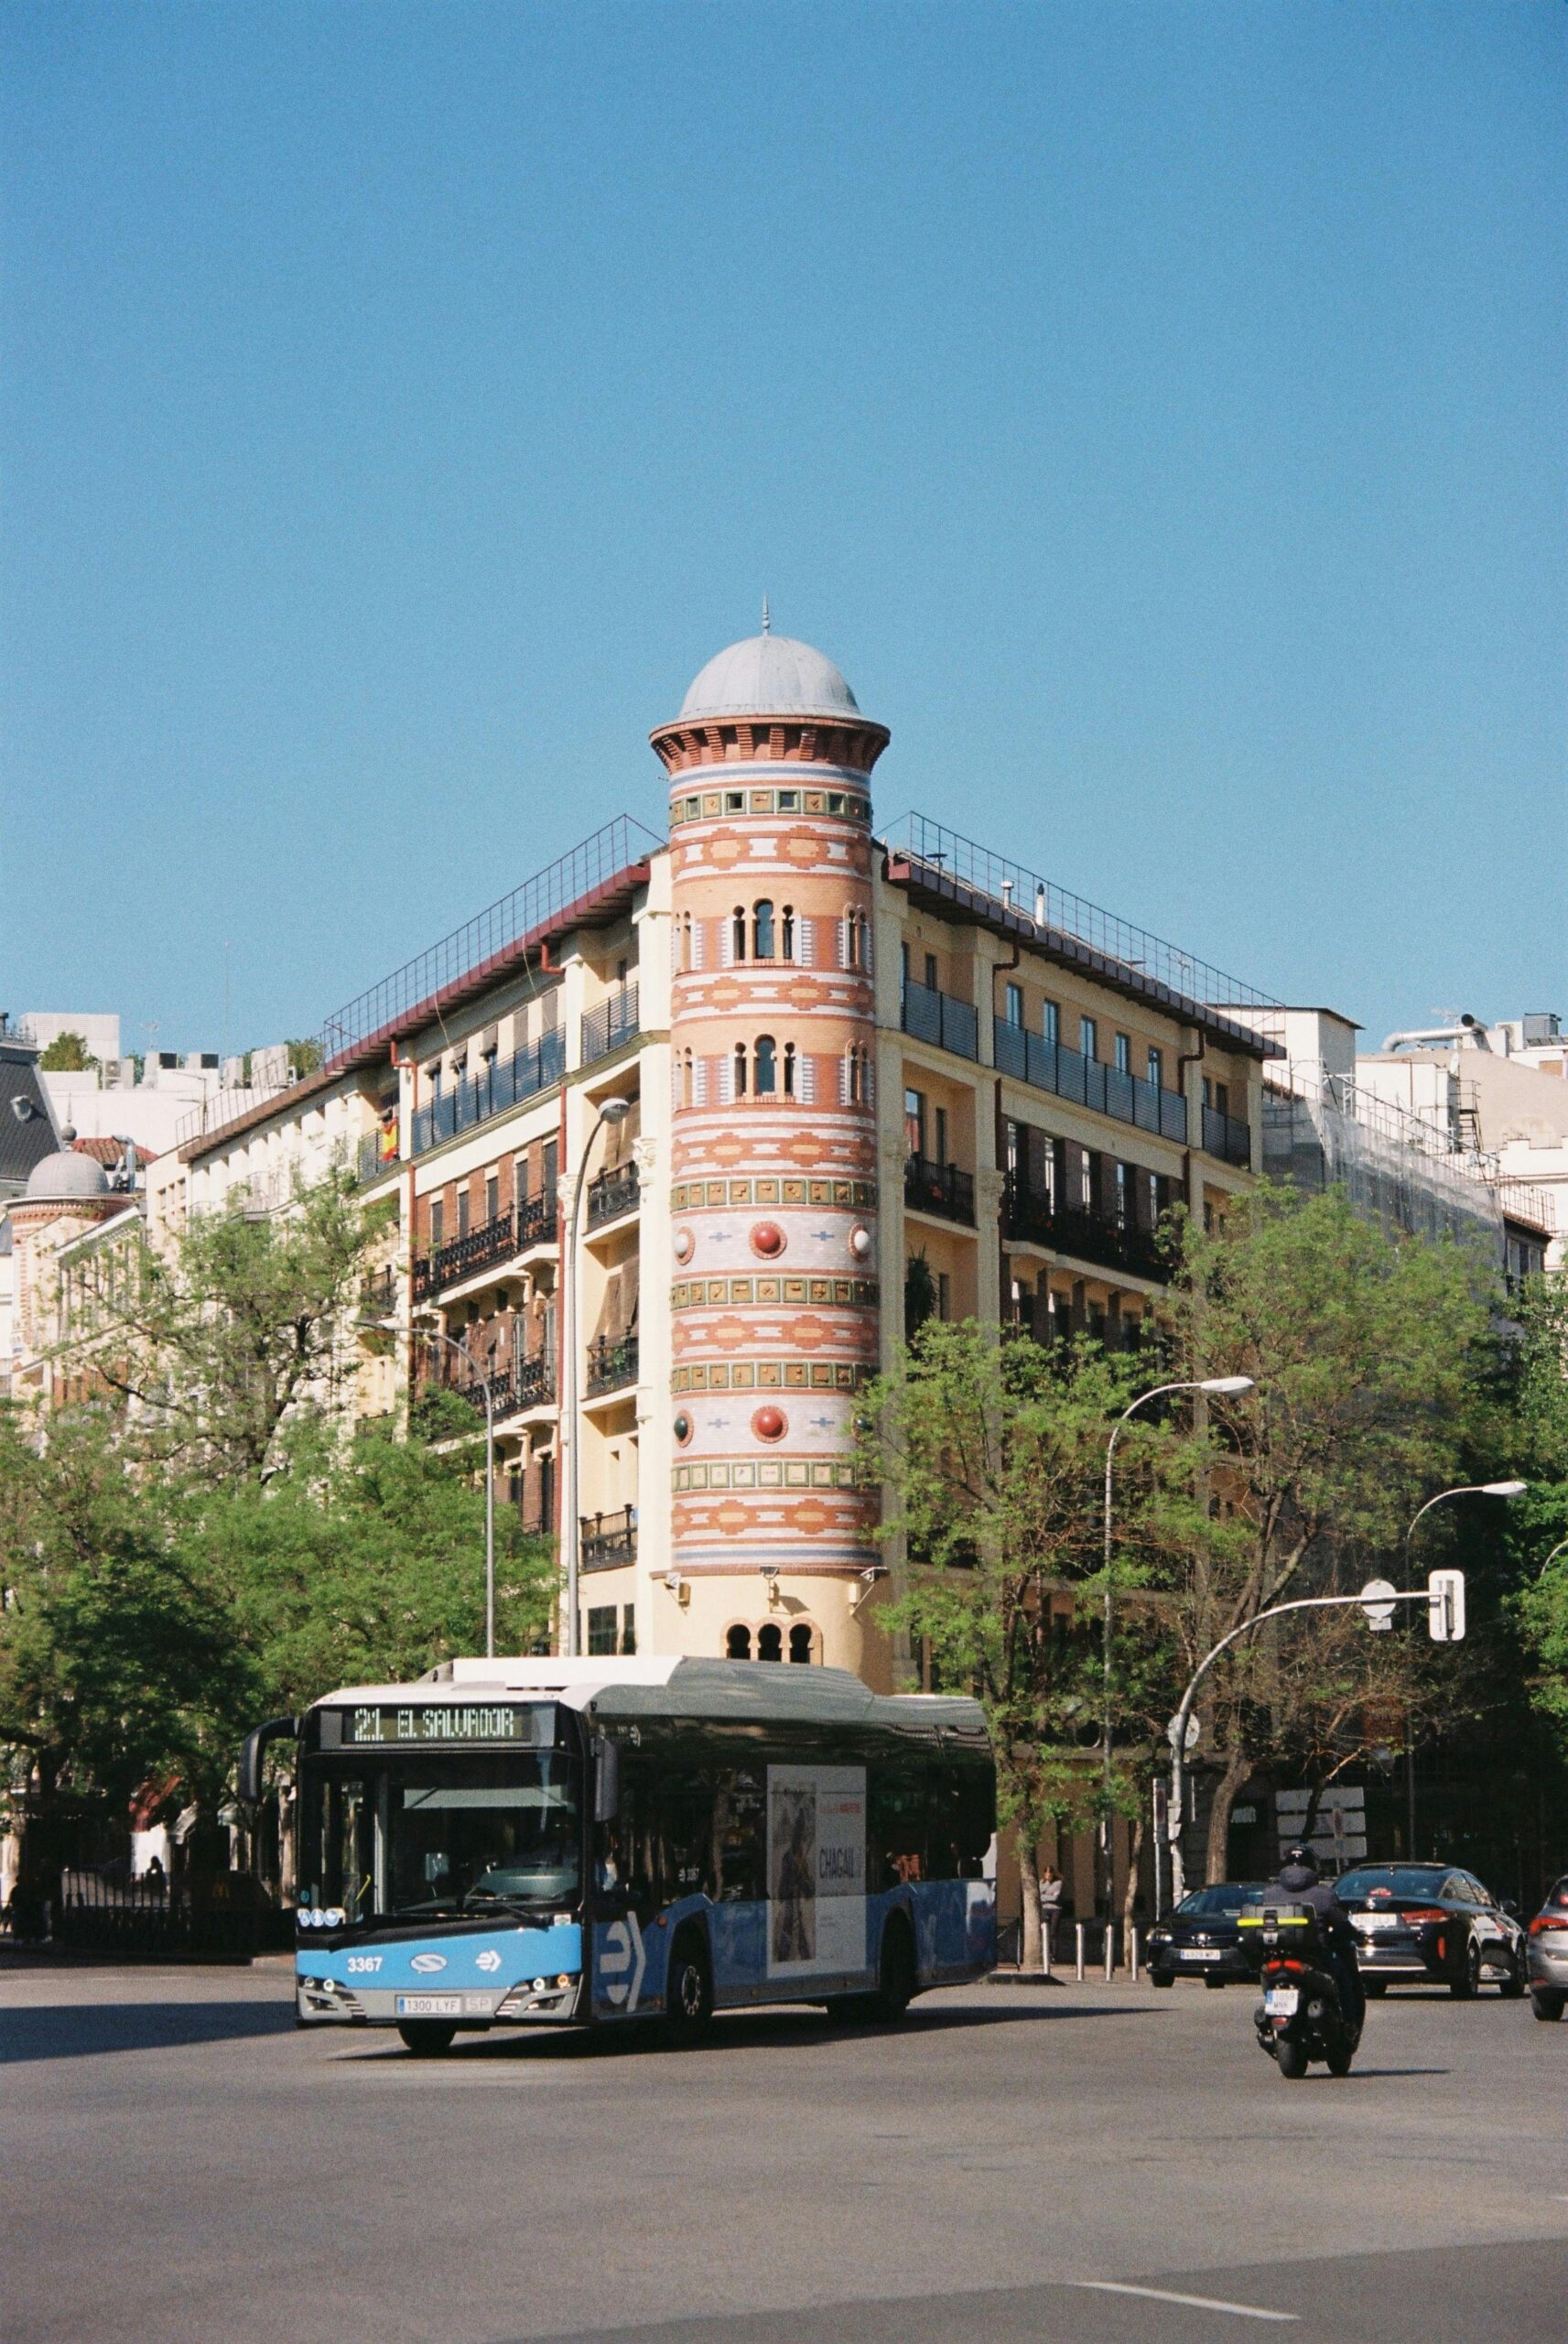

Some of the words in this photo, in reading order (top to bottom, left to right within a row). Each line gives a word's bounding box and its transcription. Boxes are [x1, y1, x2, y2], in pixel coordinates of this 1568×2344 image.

[355, 1708, 384, 1741] 21
[397, 1709, 417, 1738] EL
[423, 1708, 514, 1737] SALVADOR
[819, 1848, 854, 1879] CHAGALL
[347, 1956, 383, 1972] 3367
[407, 2000, 432, 2012] 1300
[436, 2000, 458, 2012] LYF
[469, 1999, 489, 2010] SP
